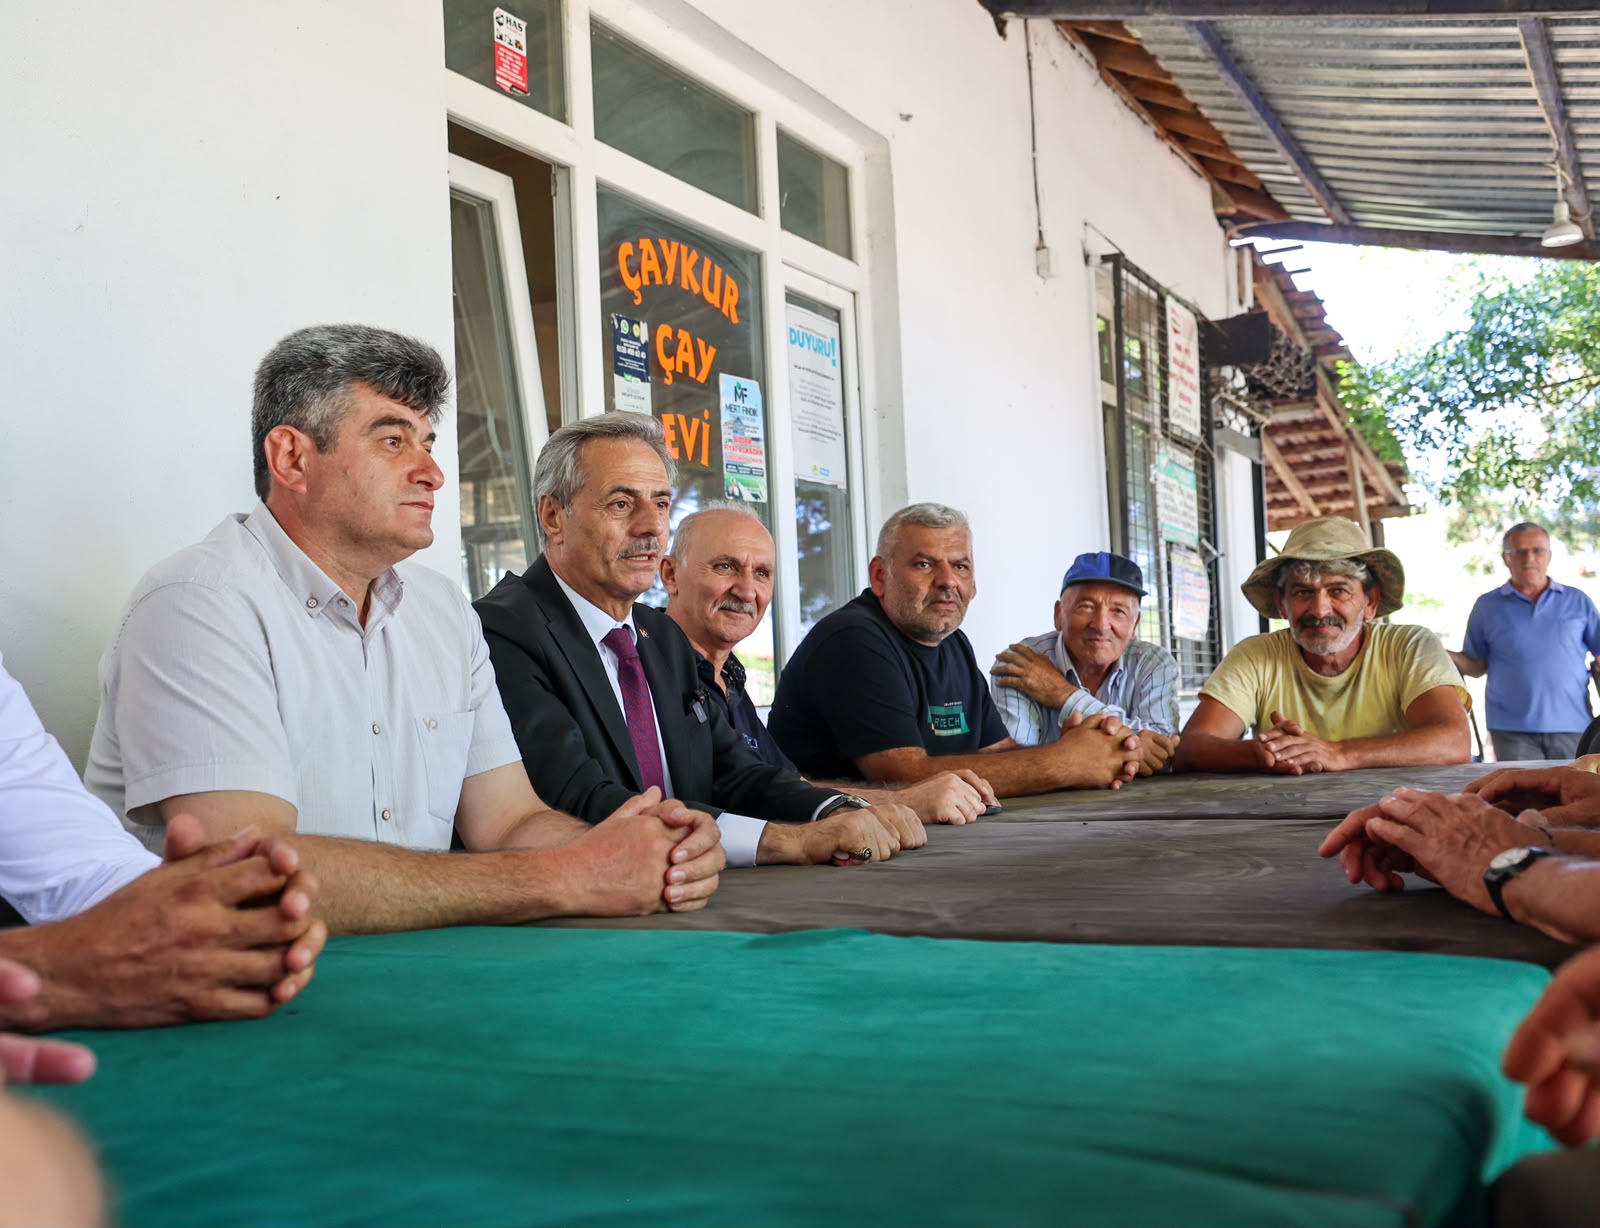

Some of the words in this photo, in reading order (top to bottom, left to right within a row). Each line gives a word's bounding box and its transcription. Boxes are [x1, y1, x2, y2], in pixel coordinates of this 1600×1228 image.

[506, 16, 523, 32] HAS
[618, 238, 739, 324] ÇAYKUR
[655, 323, 717, 385] ÇAY
[789, 327, 837, 368] DUYURU!
[725, 403, 741, 414] MERT
[734, 385, 748, 404] MF
[661, 409, 711, 467] EVİ
